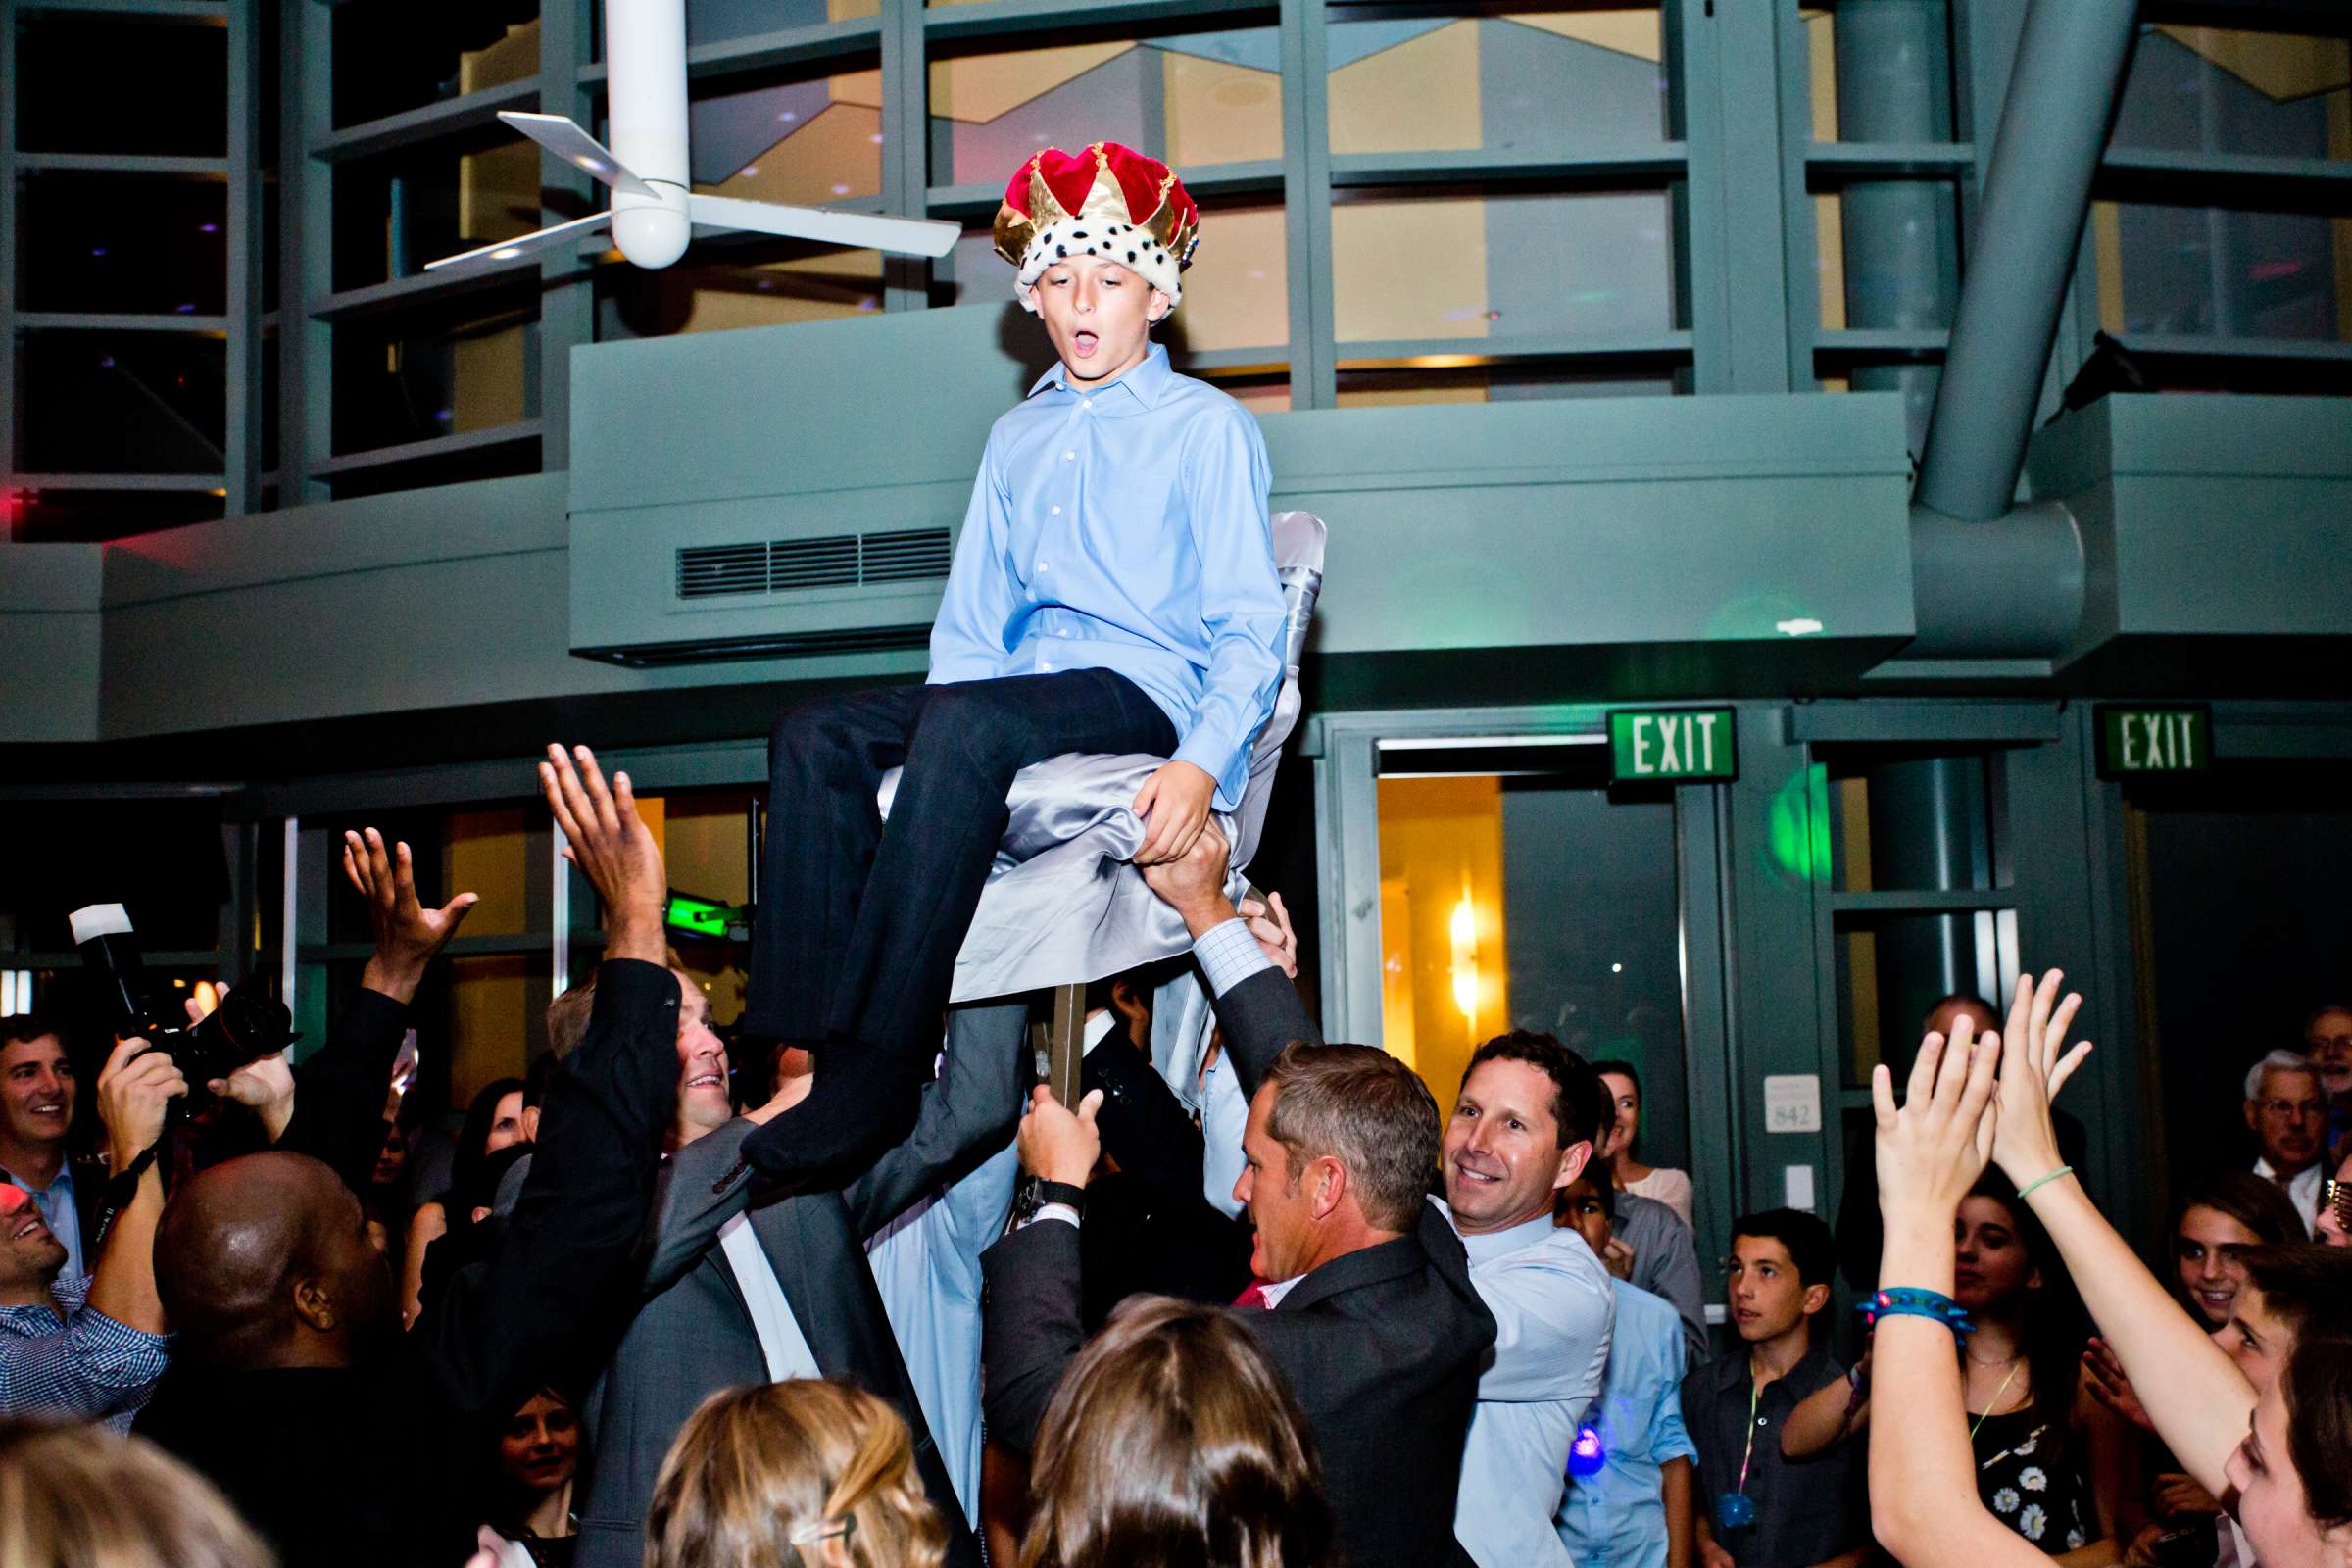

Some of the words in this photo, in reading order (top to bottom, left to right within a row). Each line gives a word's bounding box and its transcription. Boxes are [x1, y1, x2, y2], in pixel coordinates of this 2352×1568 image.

[1633, 714, 1717, 773] EXIT
[2121, 713, 2193, 769] EXIT
[1774, 1104, 1811, 1127] 842
